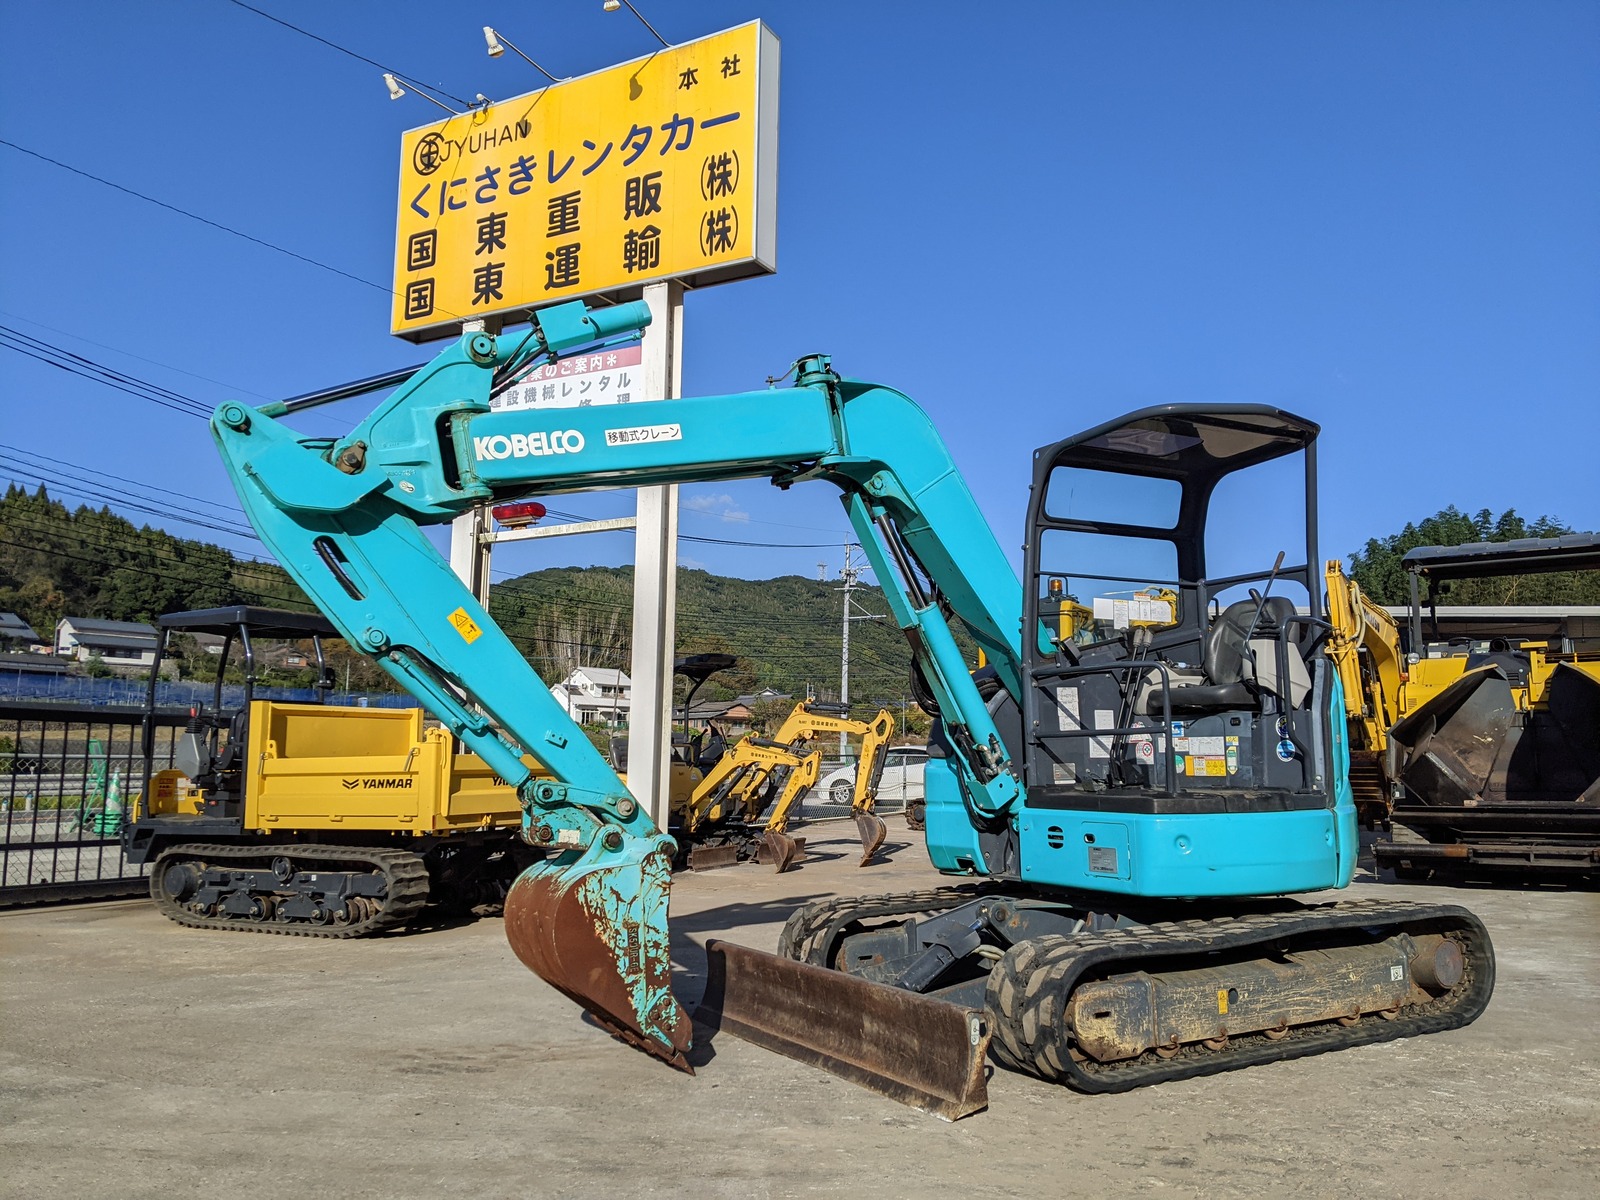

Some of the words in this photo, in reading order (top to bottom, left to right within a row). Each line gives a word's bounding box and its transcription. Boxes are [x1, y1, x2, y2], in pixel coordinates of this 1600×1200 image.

[678, 54, 741, 90] 本社
[440, 118, 529, 162] JYUHAN
[410, 112, 741, 218] くにさきレンタカー
[473, 429, 585, 461] KOBELCO
[607, 427, 679, 443] 移動式クレーン
[362, 778, 413, 789] YANMAR
